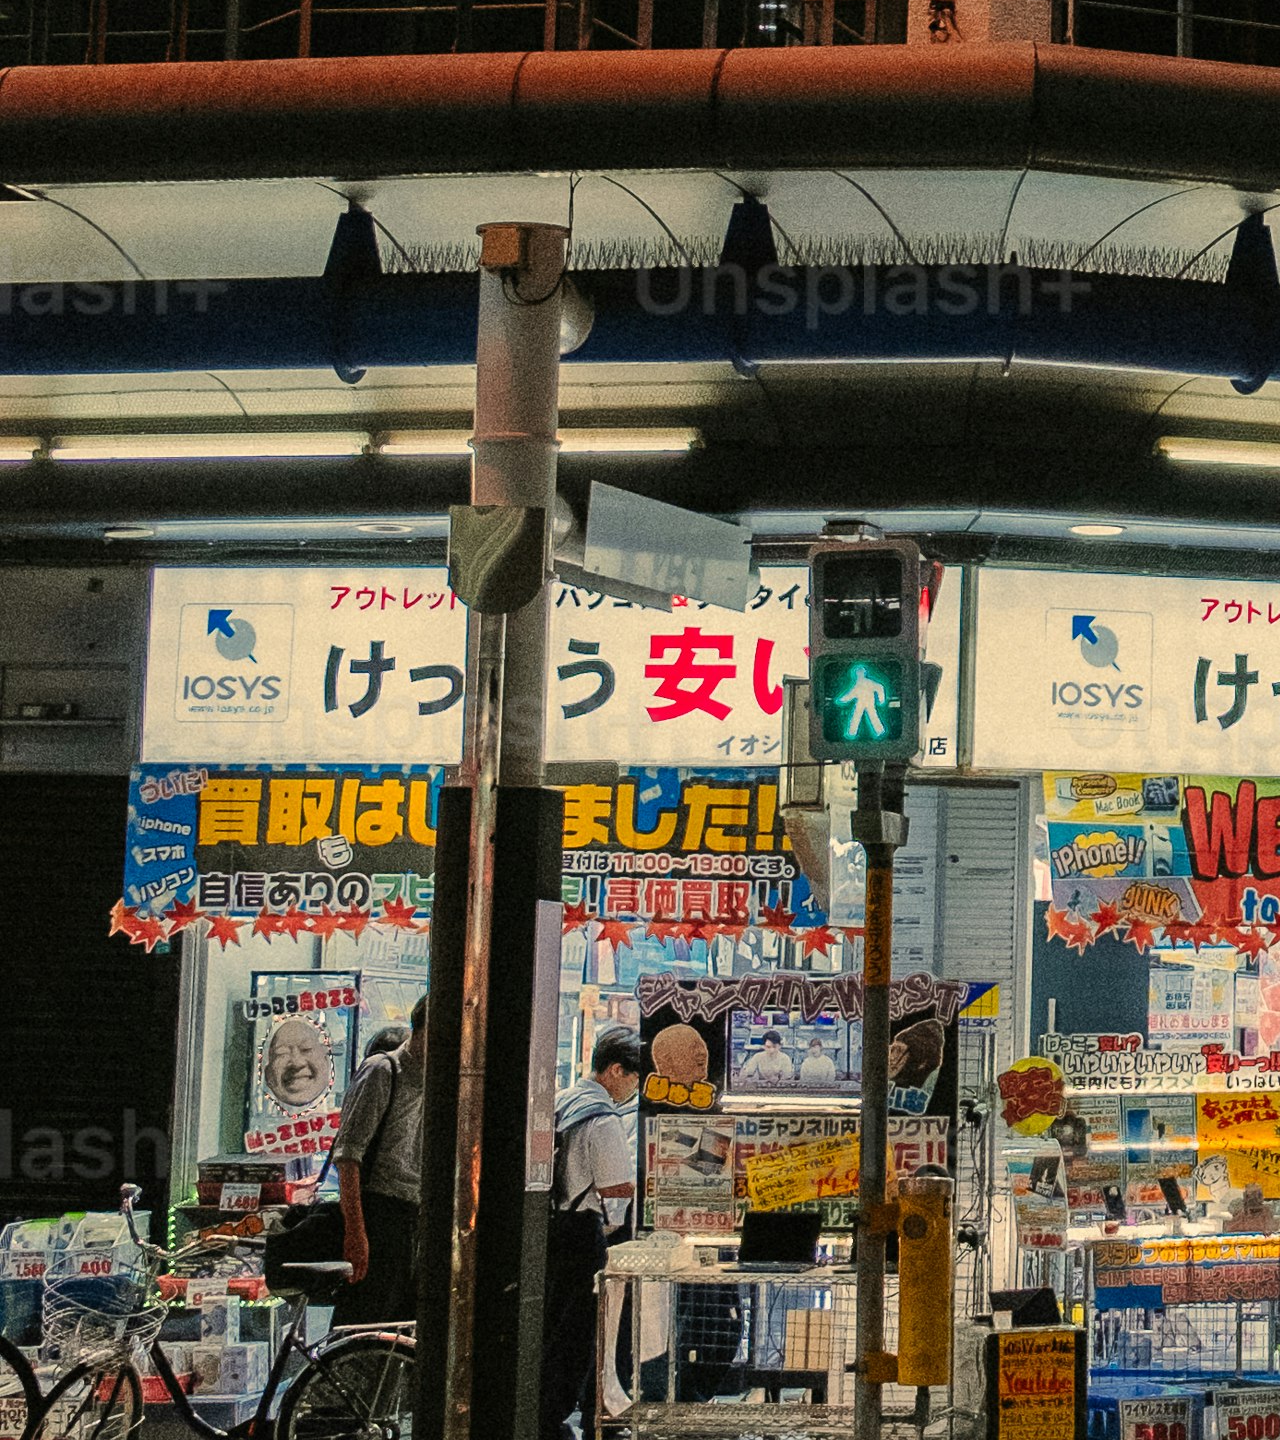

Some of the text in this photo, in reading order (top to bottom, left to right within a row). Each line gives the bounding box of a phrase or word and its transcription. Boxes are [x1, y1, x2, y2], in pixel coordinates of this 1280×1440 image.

[182, 675, 282, 701] IOSYS
[324, 639, 616, 720] けっう
[1051, 680, 1144, 708] IOSYS
[1094, 795, 1142, 814] Mac Book
[140, 815, 193, 837] iphone
[141, 844, 186, 863] スマホ
[1051, 836, 1147, 878] iPhone!!
[140, 866, 195, 903] パソコン
[1122, 886, 1181, 918] JUNK
